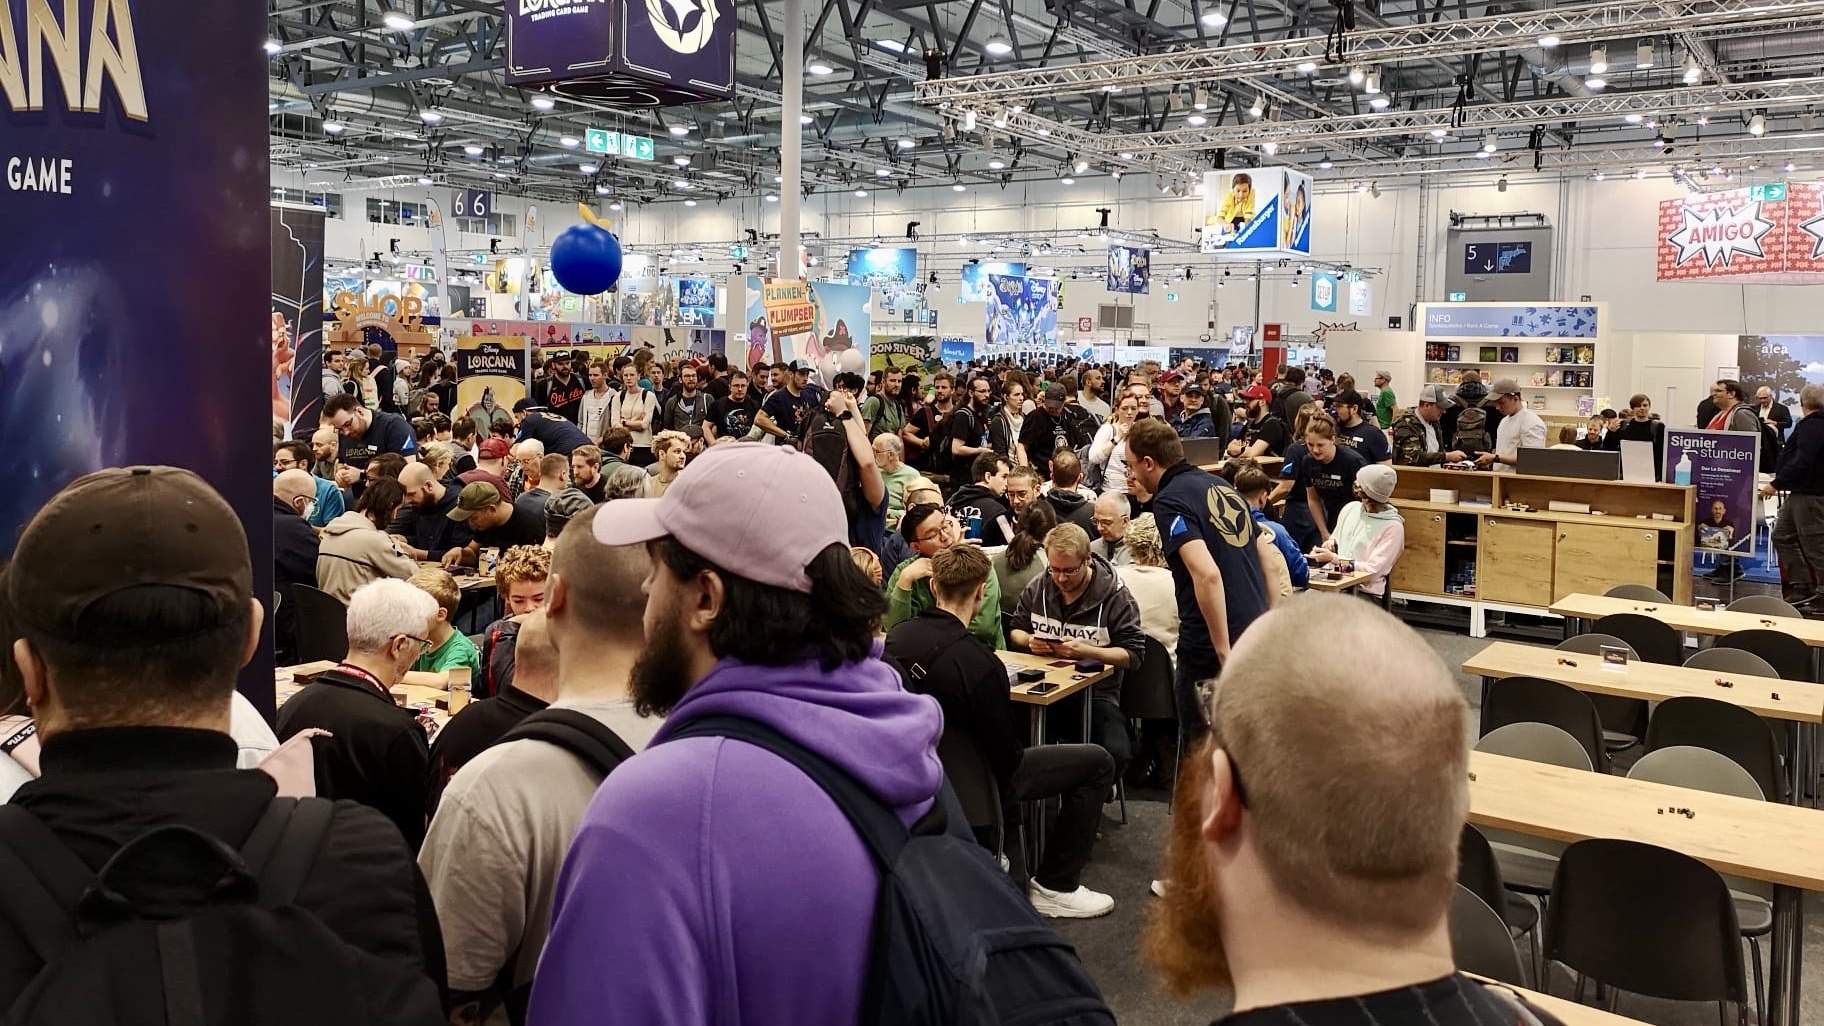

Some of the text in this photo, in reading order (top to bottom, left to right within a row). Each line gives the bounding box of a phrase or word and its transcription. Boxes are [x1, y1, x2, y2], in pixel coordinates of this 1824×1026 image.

[531, 10, 555, 22] TRADING
[556, 7, 571, 16] CARD
[572, 5, 589, 14] GAME
[7, 156, 73, 194] GAME
[455, 192, 464, 215] 6
[473, 193, 485, 216] 6
[1688, 221, 1754, 245] AMIGO
[1467, 245, 1477, 260] 5
[766, 287, 806, 300] PLANKEN-
[335, 291, 422, 325] SHOP
[770, 306, 814, 323] PLUMPSER
[1429, 314, 1451, 323] INFO
[1761, 344, 1789, 354] alea
[467, 355, 517, 370] LORCANA
[1670, 435, 1718, 450] Signier
[1700, 447, 1753, 461] stunden
[1031, 621, 1097, 640] DONNAY
